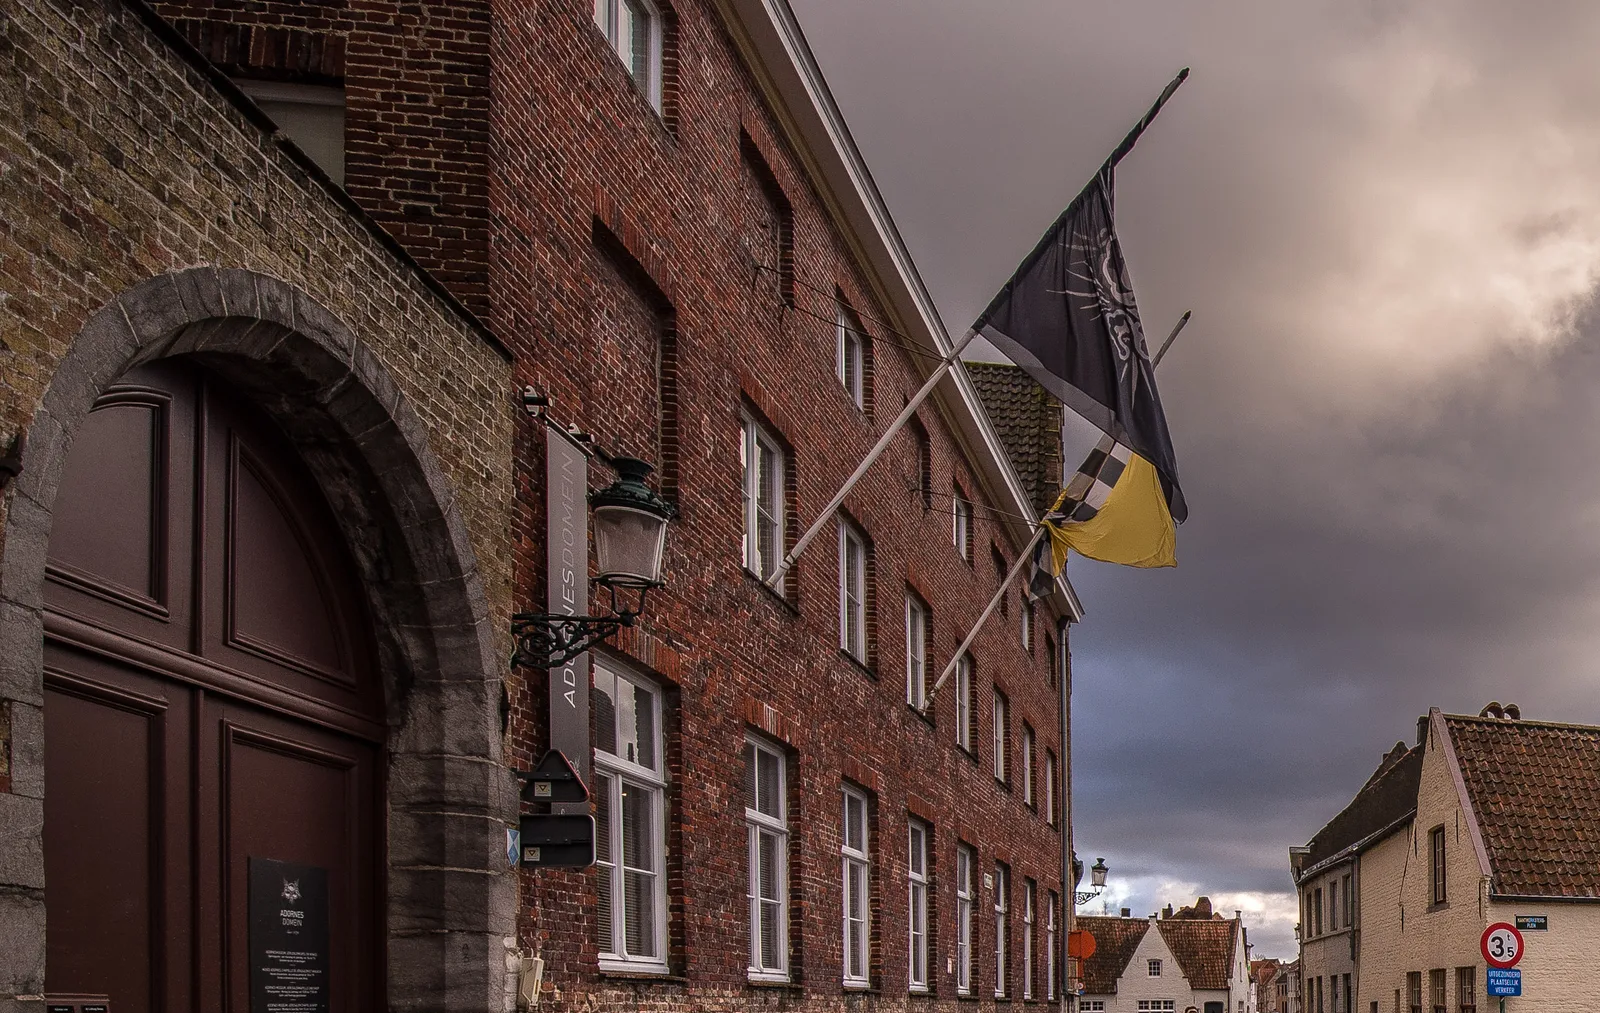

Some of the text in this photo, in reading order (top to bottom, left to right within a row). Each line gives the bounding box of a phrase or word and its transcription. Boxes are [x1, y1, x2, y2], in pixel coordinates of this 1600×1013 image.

[280, 910, 304, 918] ADORNES
[1491, 936, 1504, 957] 3
[1507, 947, 1514, 957] 5
